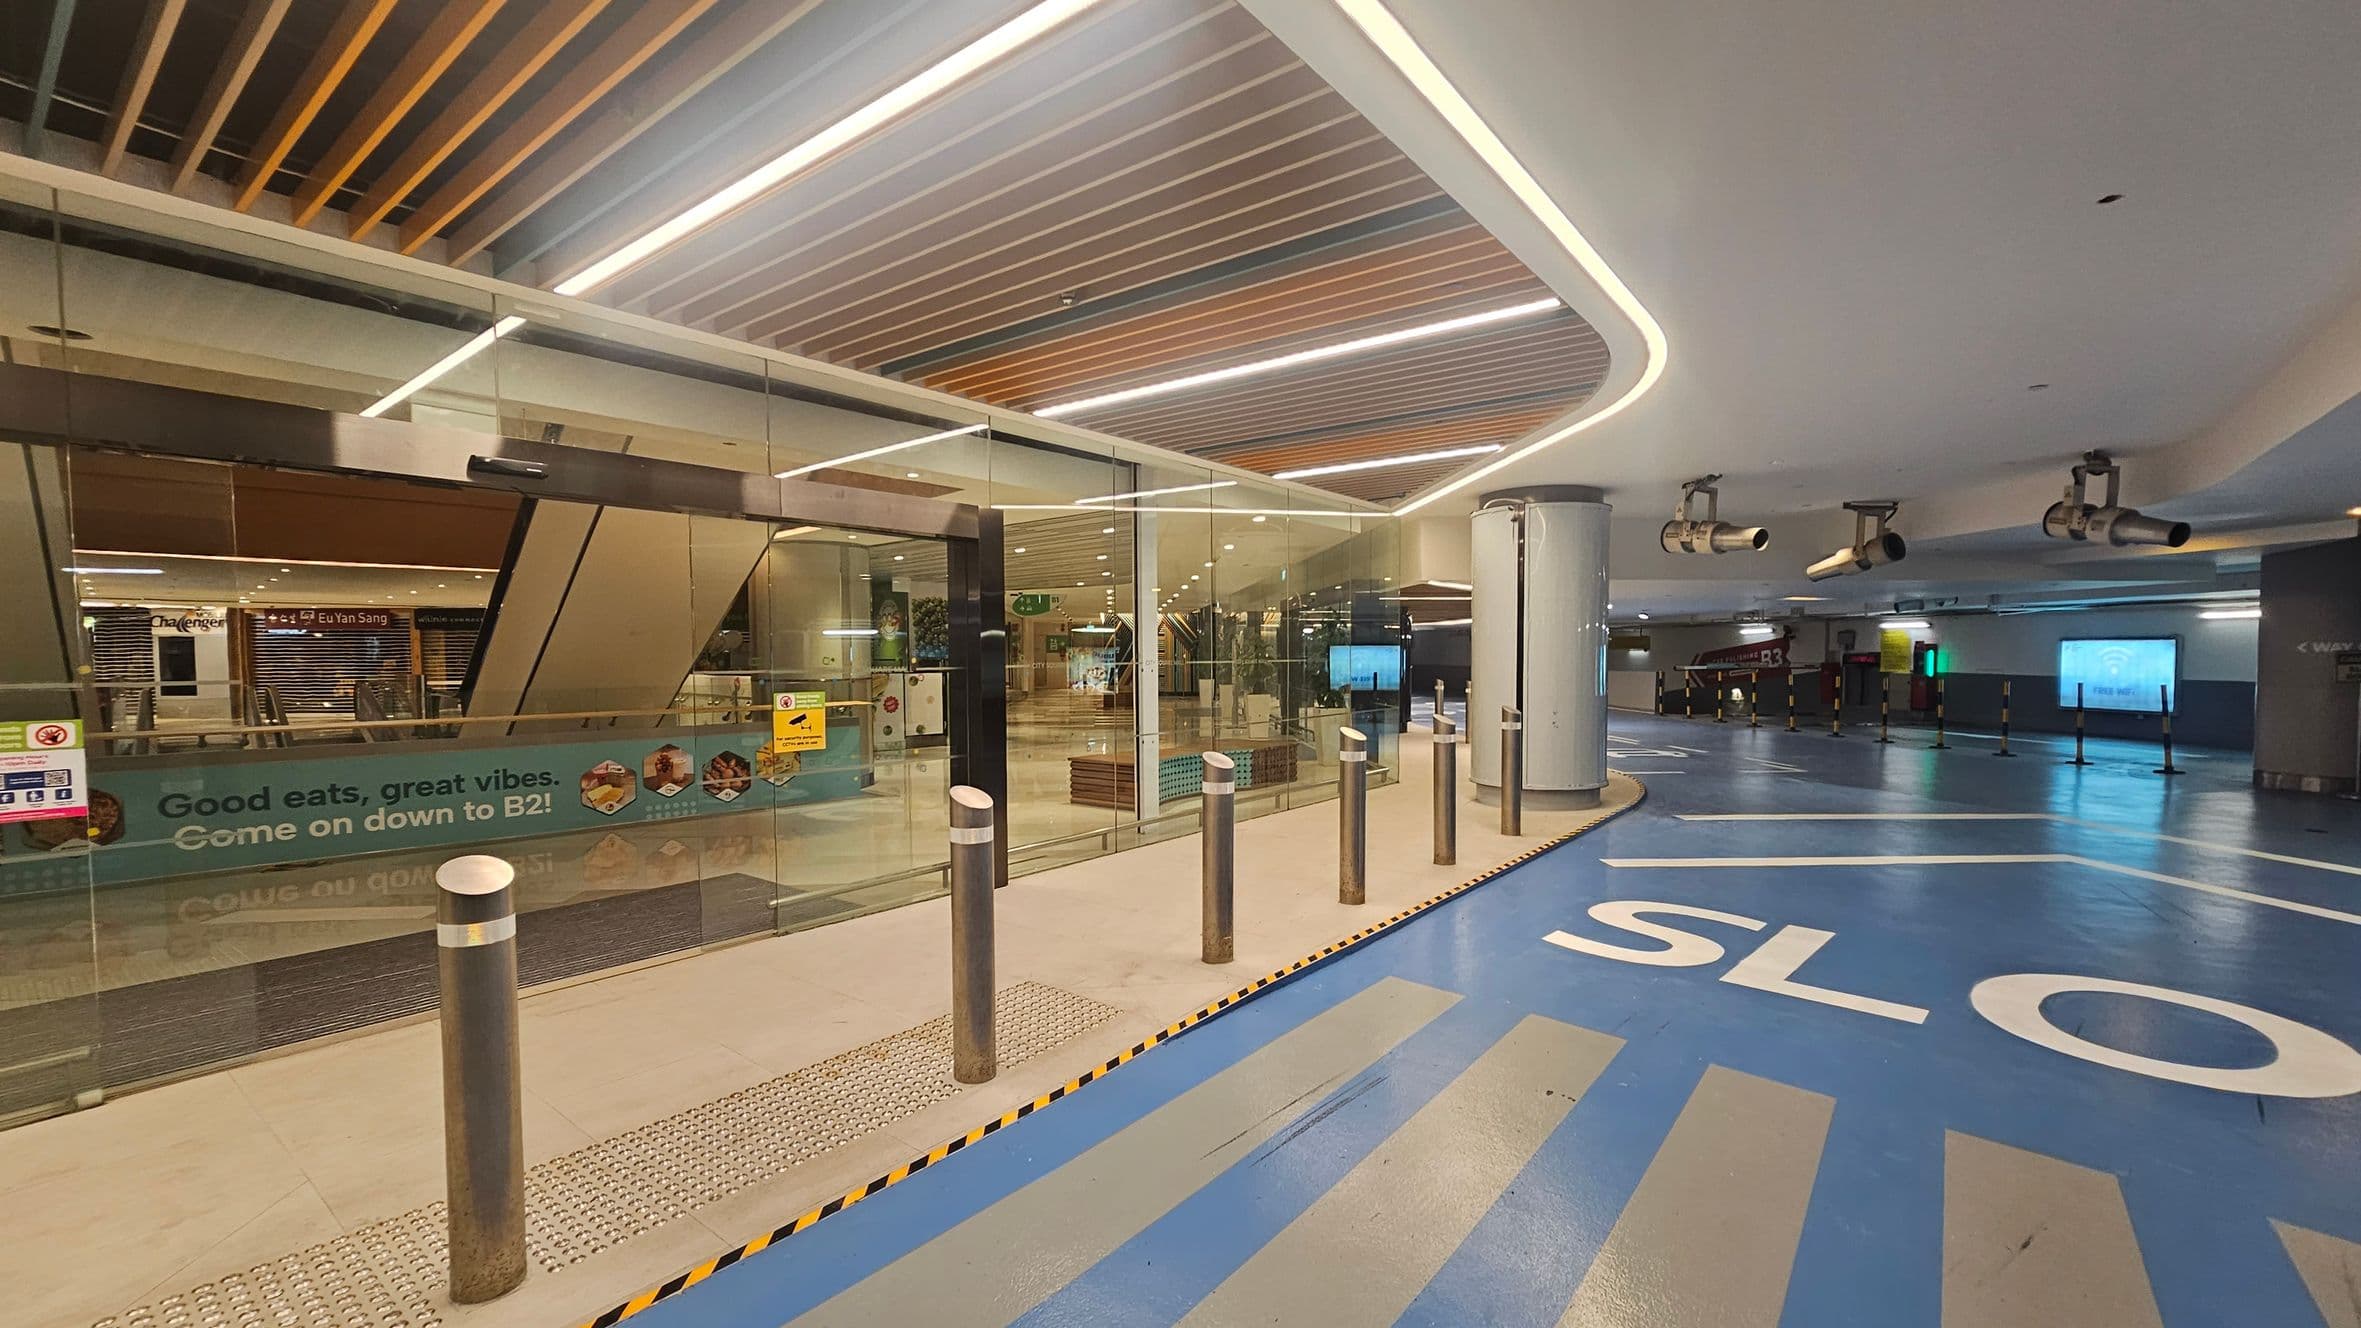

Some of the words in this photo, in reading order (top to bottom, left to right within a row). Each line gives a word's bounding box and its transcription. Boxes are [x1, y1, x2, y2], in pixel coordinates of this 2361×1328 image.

[150, 614, 225, 633] Challenger
[318, 612, 334, 624] Eu
[335, 612, 356, 624] Yan
[358, 612, 388, 626] Sang
[1760, 647, 1783, 668] B3
[158, 786, 271, 818] Good
[283, 782, 369, 809] eats,
[380, 774, 466, 806] great
[474, 768, 560, 793] vibes.
[174, 822, 298, 850] Come
[308, 816, 353, 838] on
[364, 807, 454, 832] down
[463, 801, 495, 822] to
[504, 793, 553, 818] B2!
